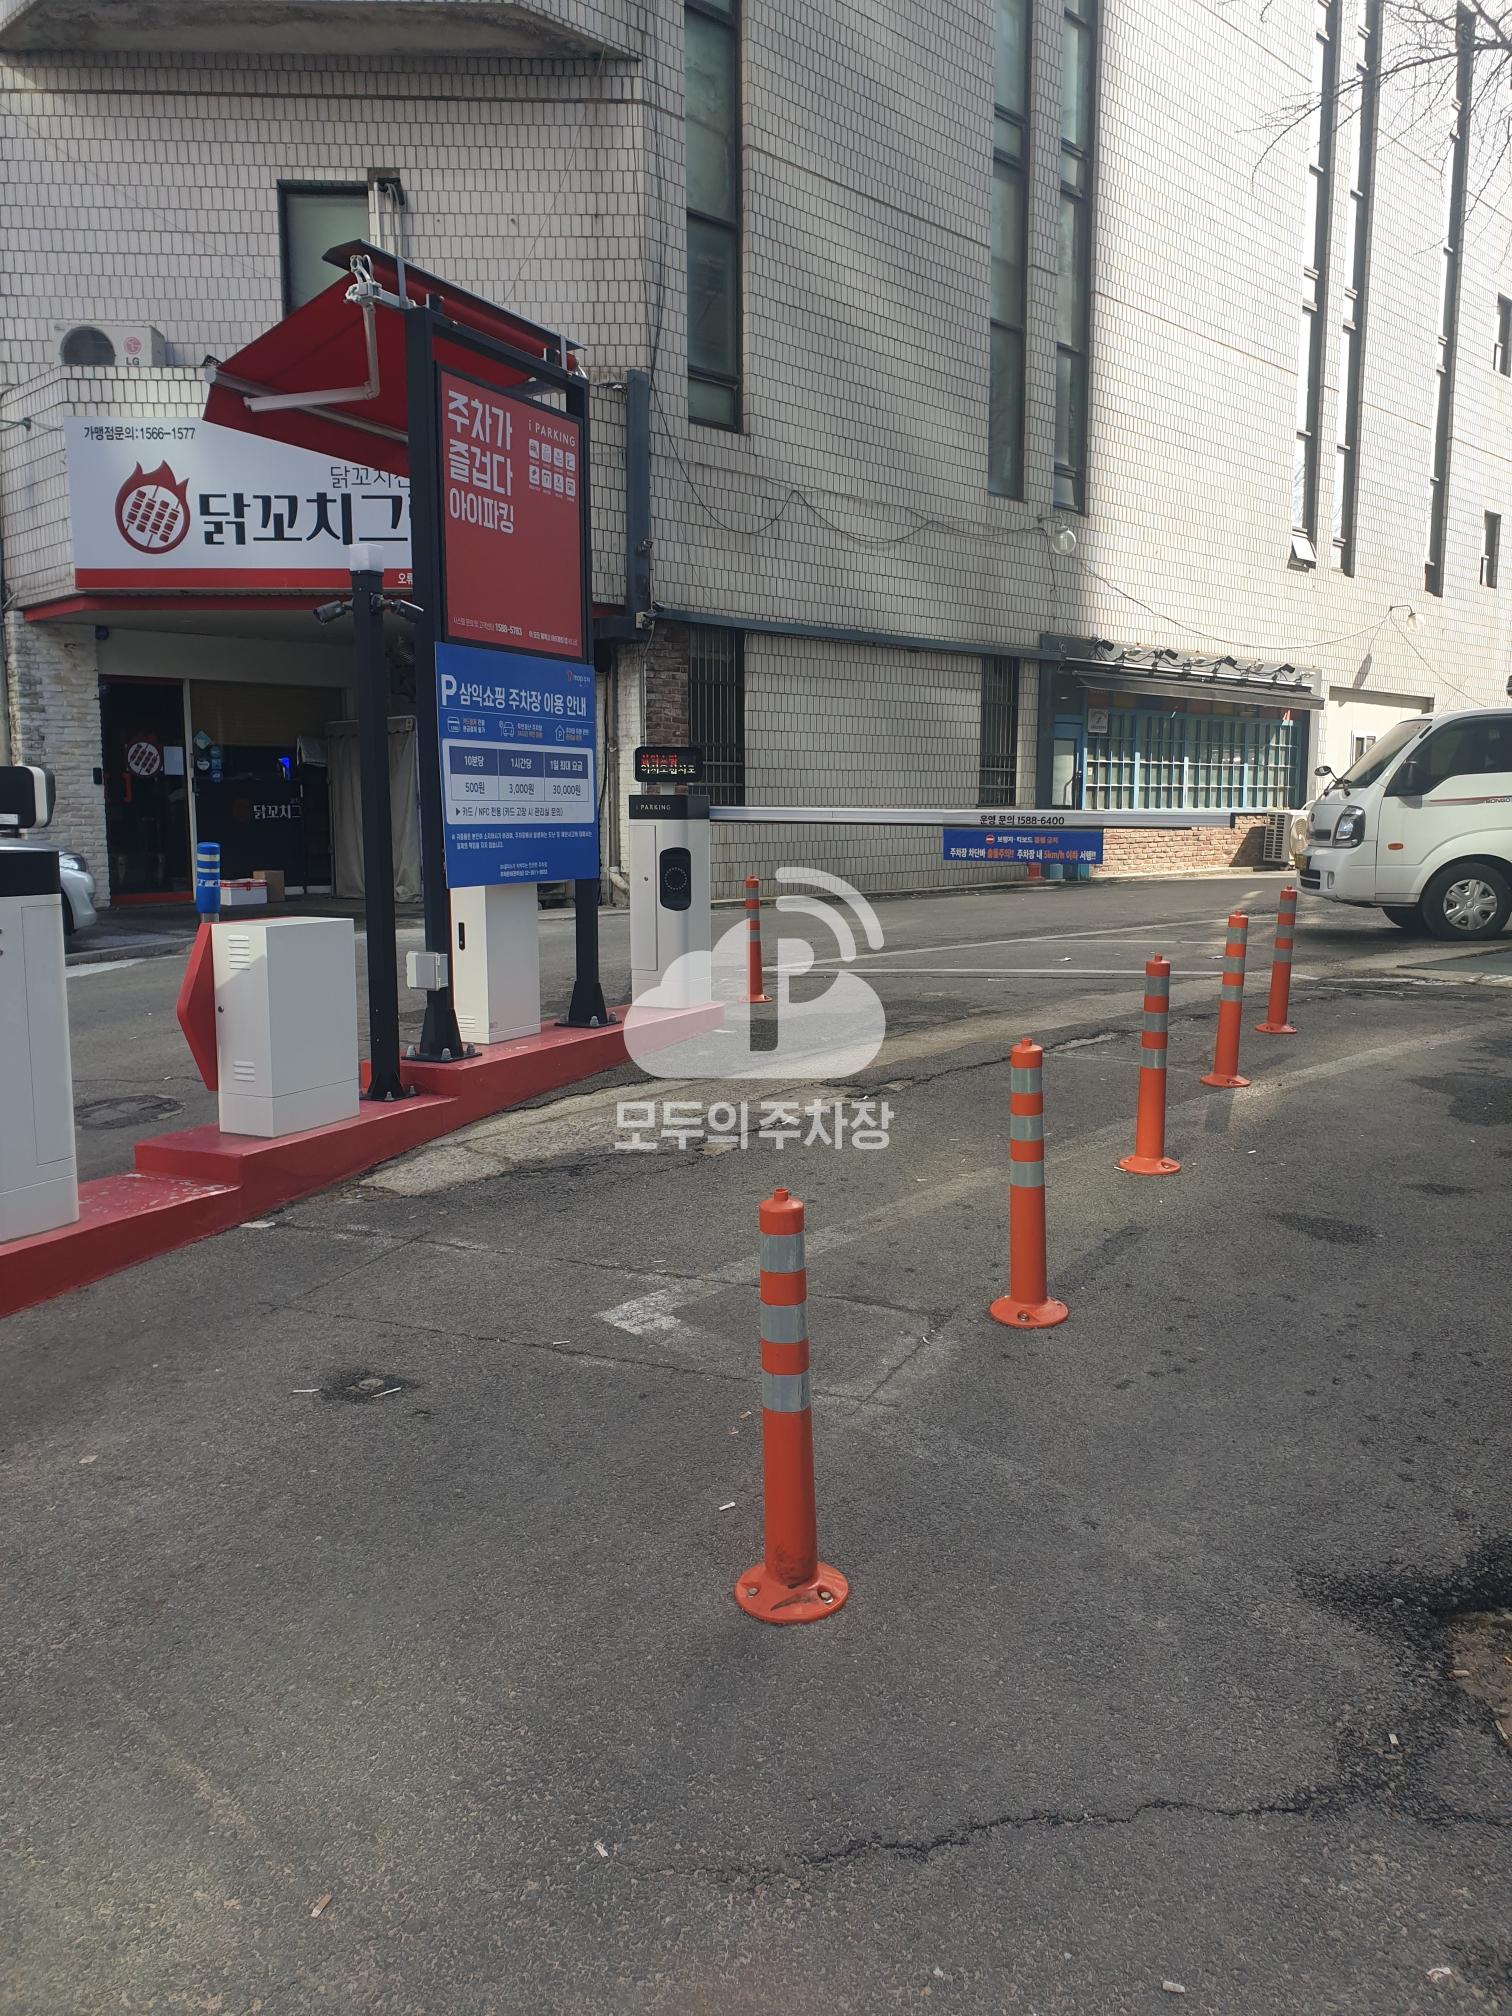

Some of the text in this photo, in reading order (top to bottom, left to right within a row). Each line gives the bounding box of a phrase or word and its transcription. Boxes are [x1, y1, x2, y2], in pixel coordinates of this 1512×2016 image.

[125, 357, 140, 366] LG
[448, 390, 513, 450] 주차가
[83, 426, 196, 441] 가맹점문의:1566-1577
[535, 422, 576, 447] PARKING
[449, 438, 513, 496] 즐겁다
[450, 488, 514, 533] 아이파킹
[199, 492, 411, 545] 닭꼬치그
[440, 673, 587, 717] P 삼익쇼핑 주차장 이용 안내
[464, 755, 485, 767] 10분당
[511, 758, 533, 770] 1시간당
[465, 781, 582, 796] 500원 3,000원 30,000원
[478, 807, 490, 816] NFC
[979, 815, 1065, 825] 운영 문의 1588-6400
[950, 847, 967, 858] 주차장
[968, 848, 986, 859] 차단바
[1017, 849, 1035, 860] 주차장
[1036, 849, 1043, 860] 내
[1065, 850, 1078, 860] 이하
